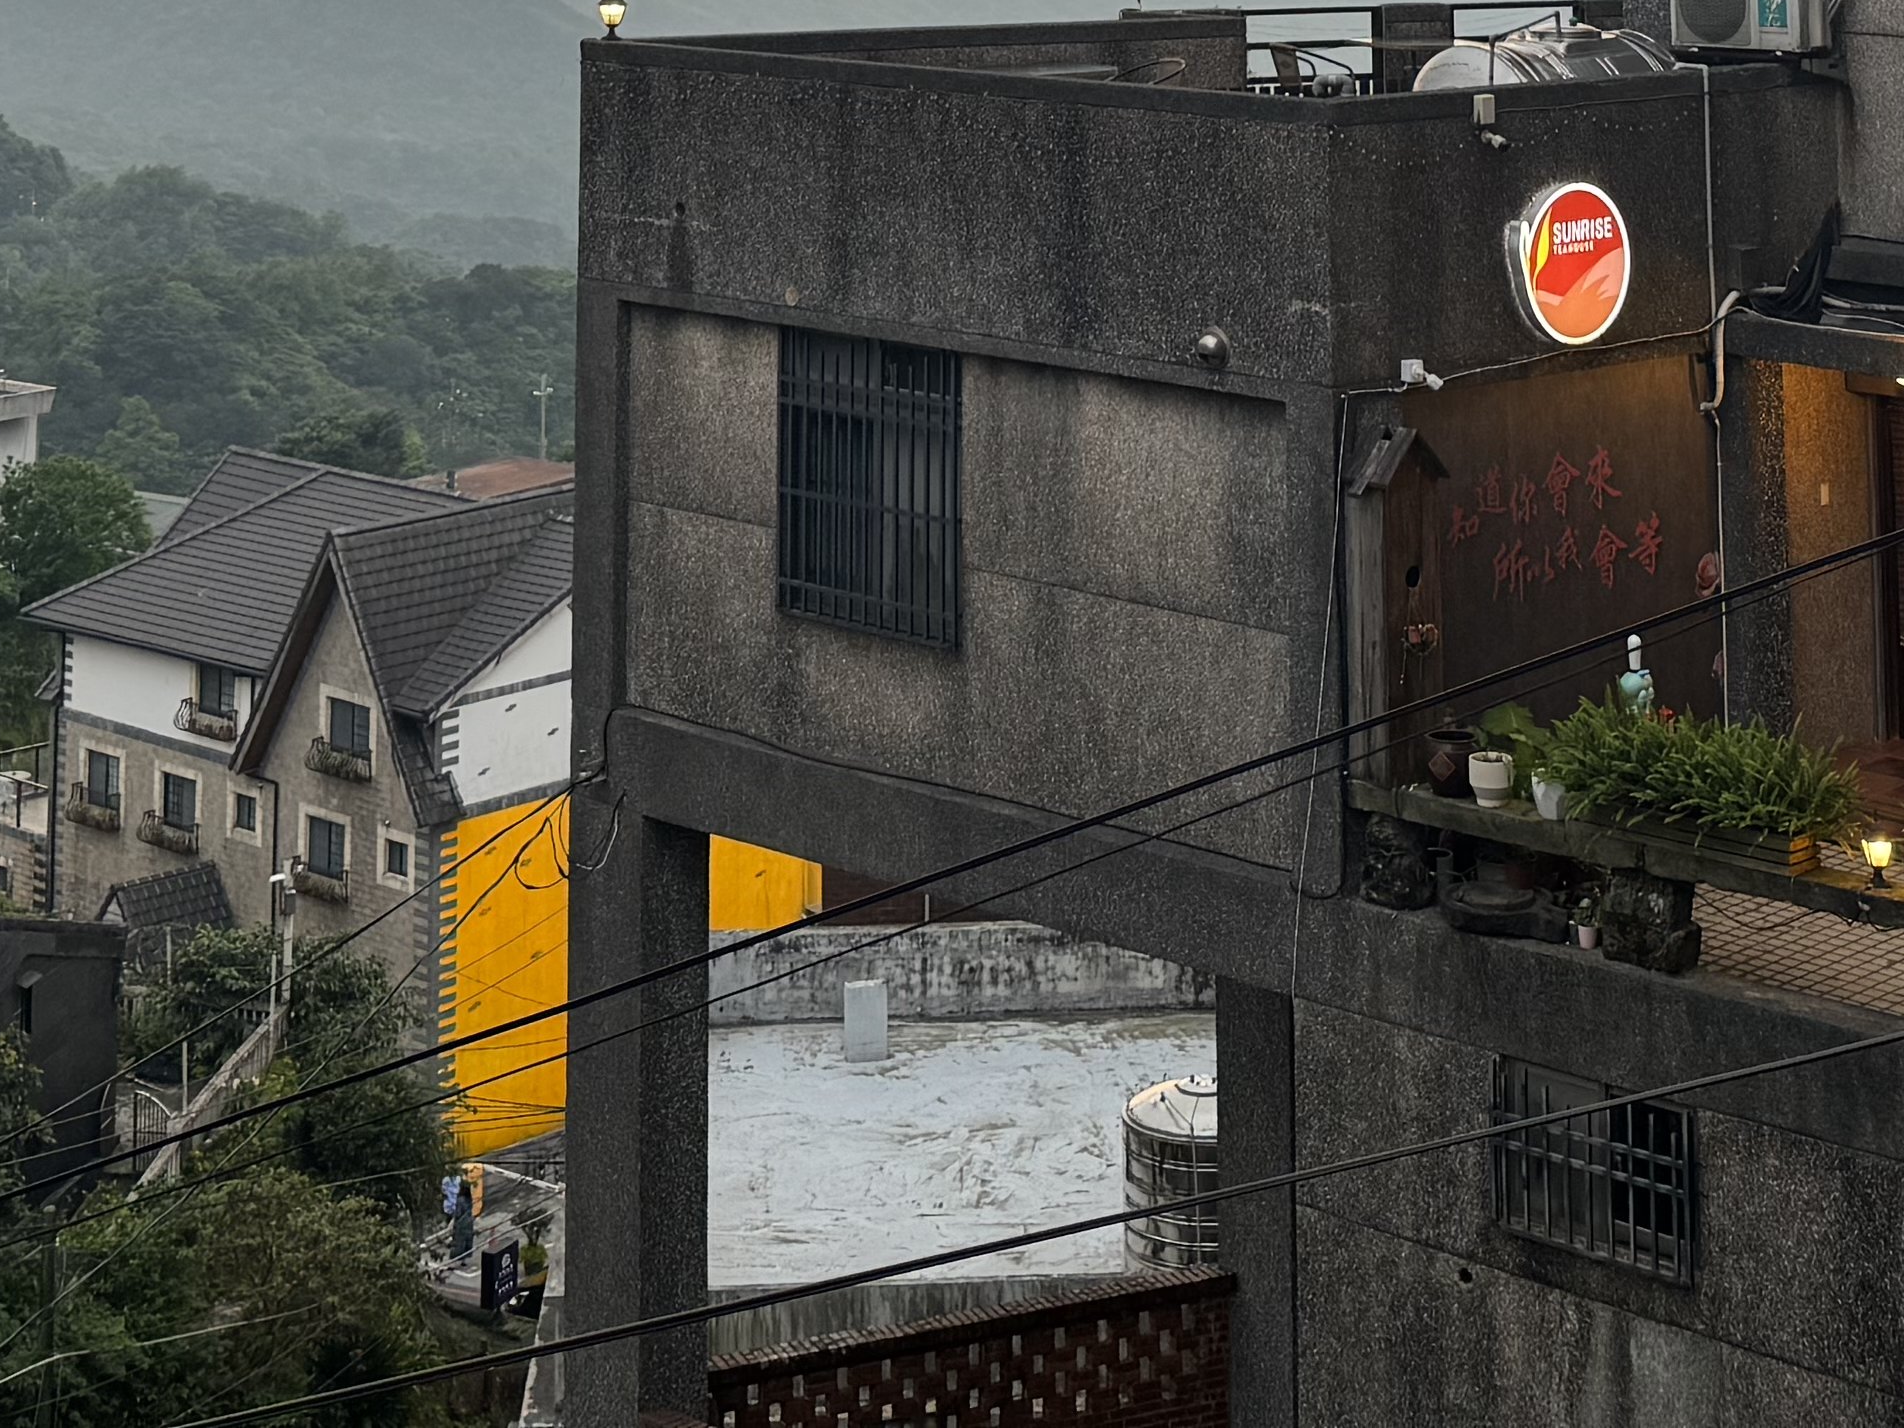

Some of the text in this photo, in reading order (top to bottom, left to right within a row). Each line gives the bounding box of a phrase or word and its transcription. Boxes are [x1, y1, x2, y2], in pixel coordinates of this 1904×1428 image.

[1553, 216, 1613, 244] SUNRISE
[1493, 511, 1663, 602] 所以我會等
